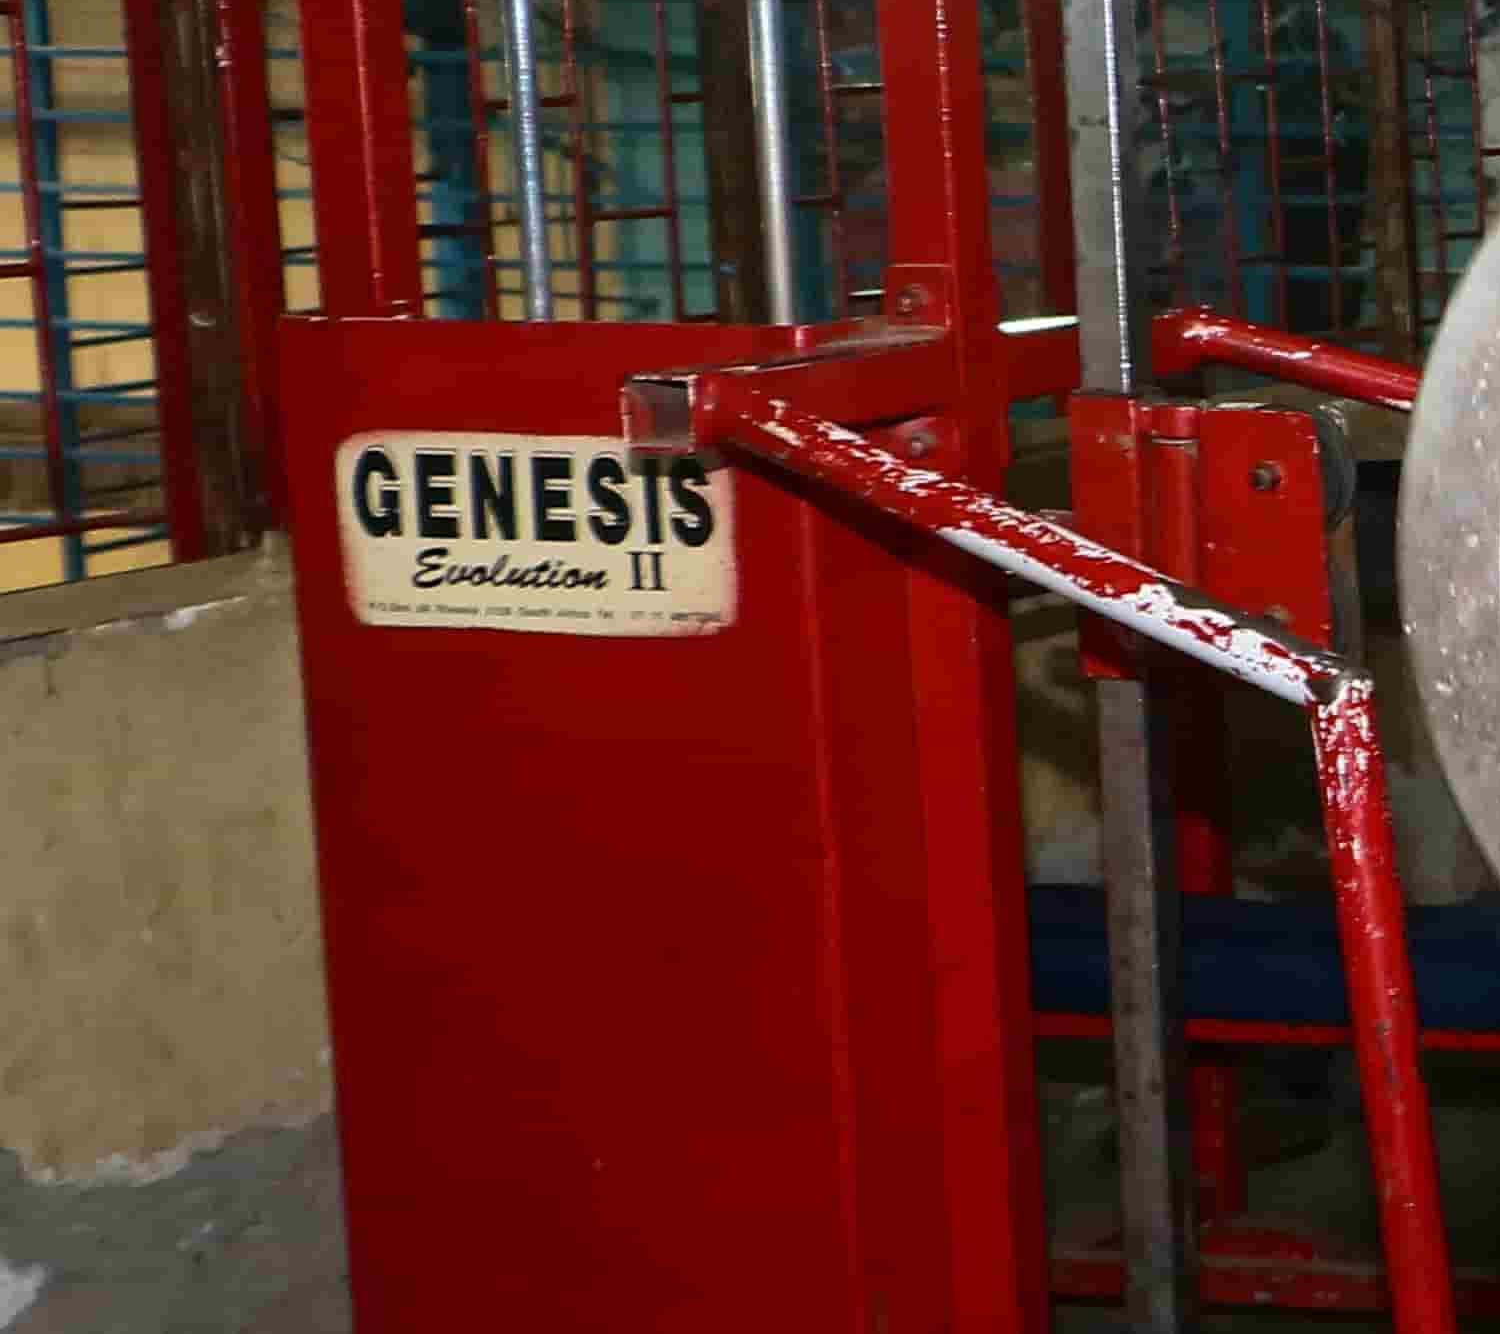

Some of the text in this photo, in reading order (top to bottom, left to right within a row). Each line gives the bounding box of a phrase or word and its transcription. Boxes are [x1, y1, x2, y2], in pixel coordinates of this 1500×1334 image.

[352, 445, 714, 548] GENESIS
[412, 547, 671, 592] Evolution II
